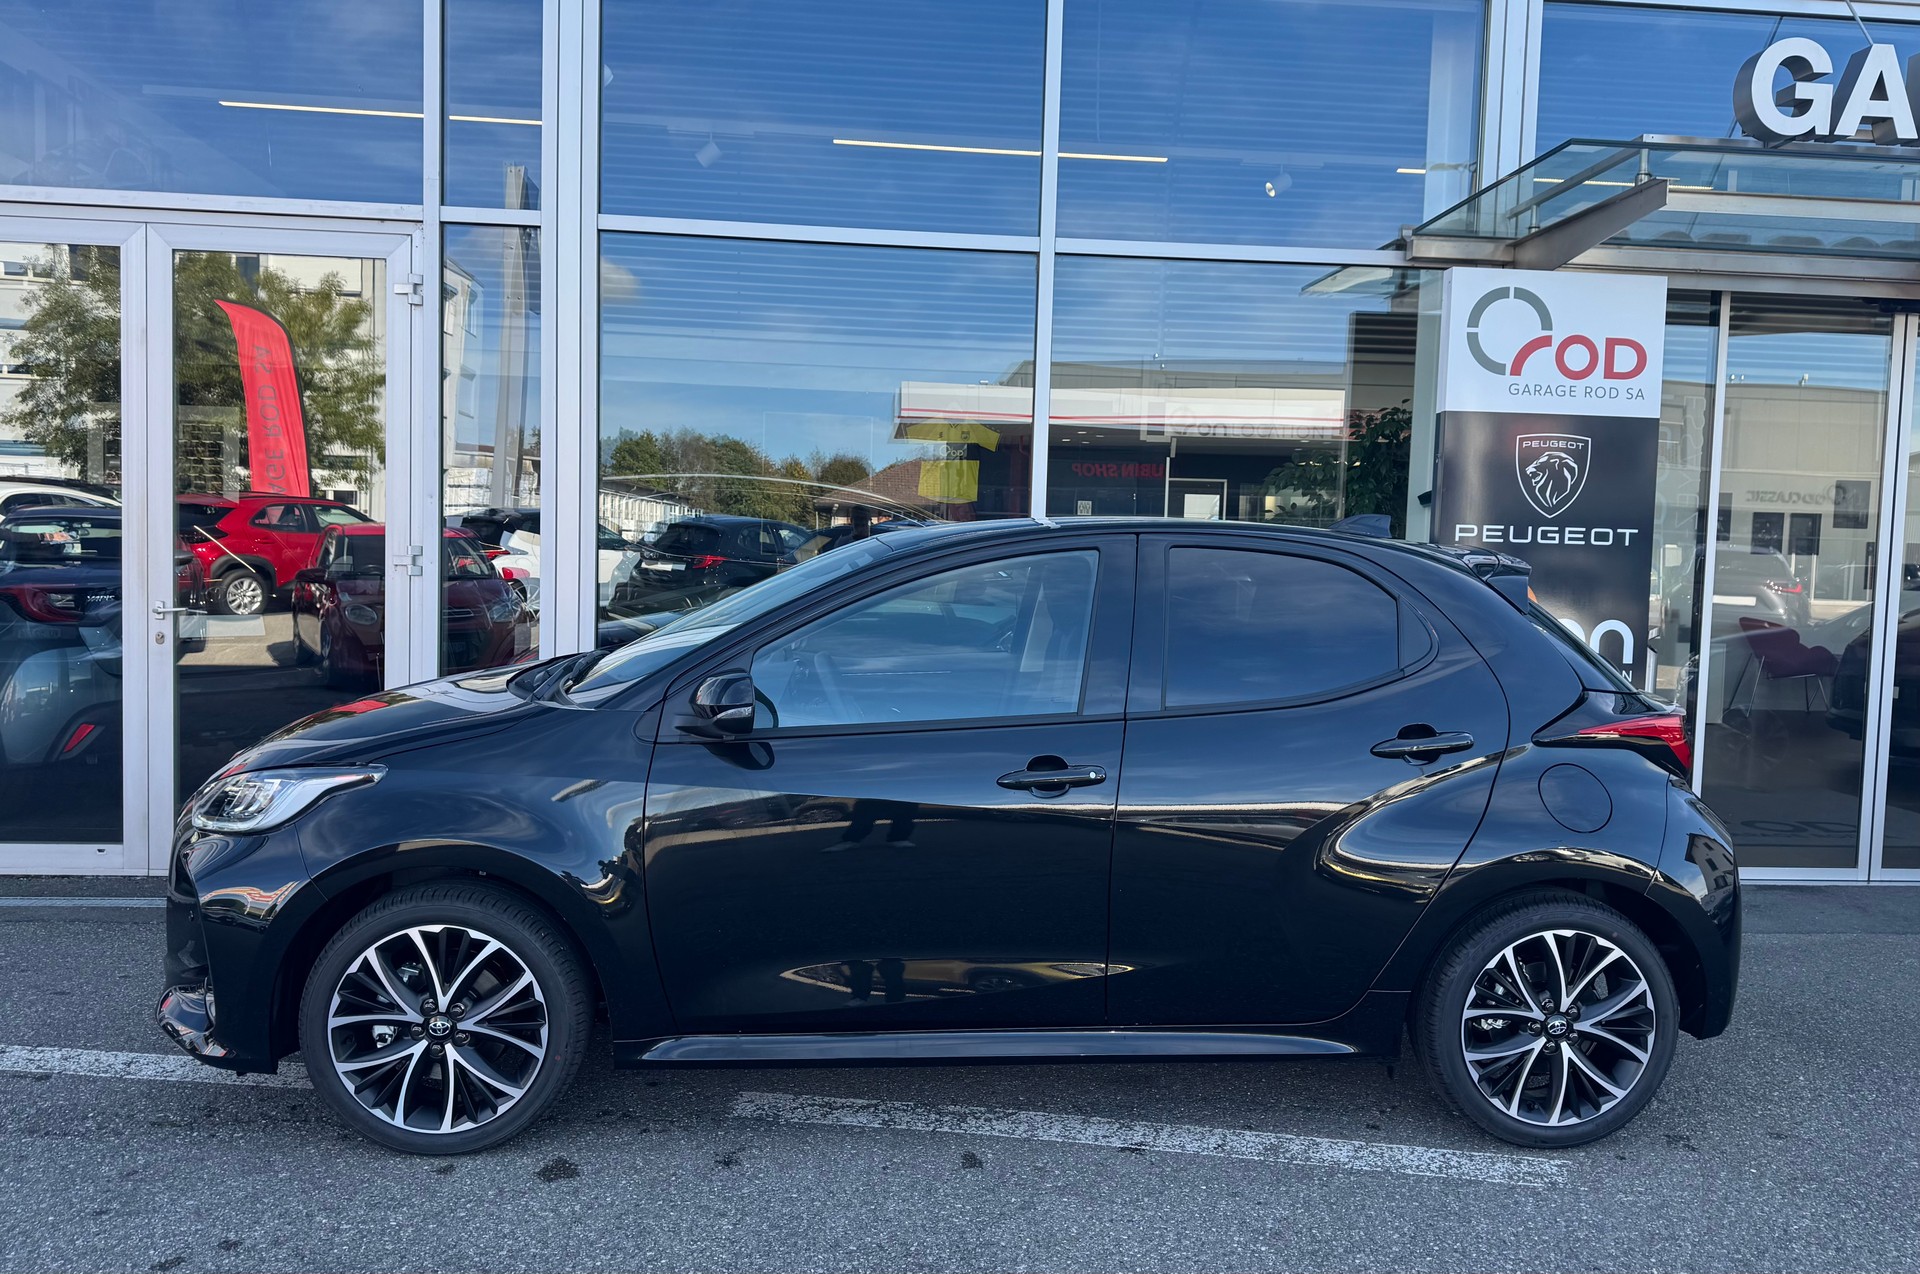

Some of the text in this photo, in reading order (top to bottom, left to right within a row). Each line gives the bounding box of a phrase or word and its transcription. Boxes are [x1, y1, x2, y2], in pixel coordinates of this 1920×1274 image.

[1744, 36, 1920, 141] GA
[1508, 382, 1645, 400] GARAGE ROD SA
[1522, 440, 1585, 450] PEUGEOT
[1454, 524, 1639, 547] PEUGEOT
